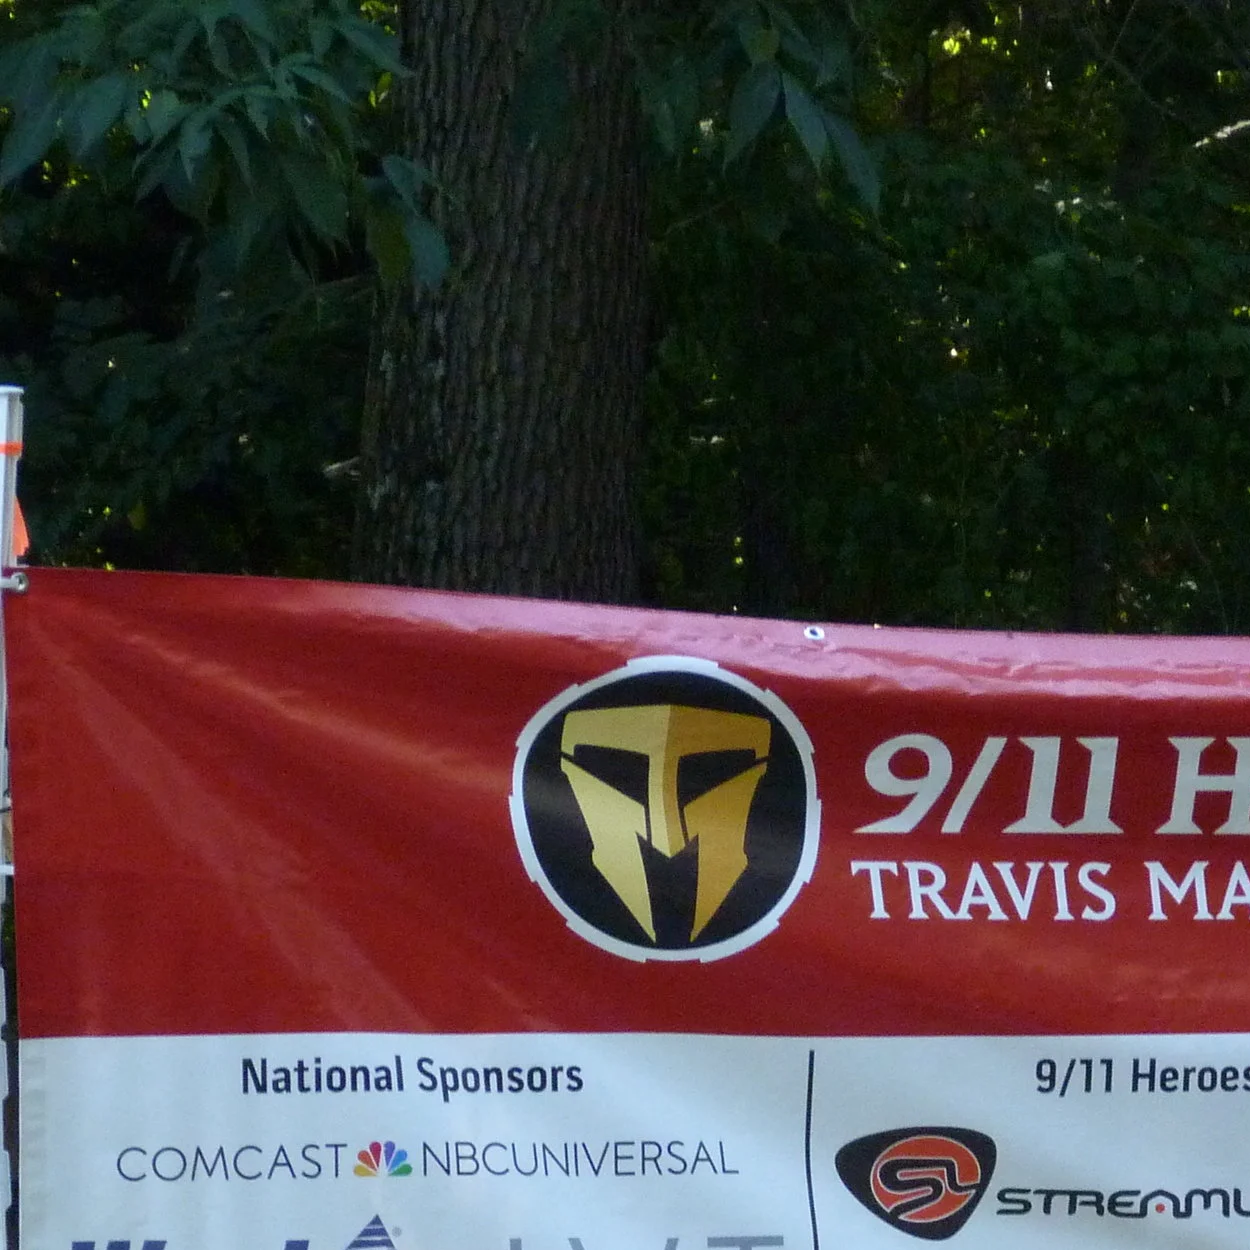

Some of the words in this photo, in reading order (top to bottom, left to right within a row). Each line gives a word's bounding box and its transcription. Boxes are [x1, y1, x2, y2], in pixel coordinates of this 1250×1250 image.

[854, 734, 1127, 835] 9/11
[851, 860, 1118, 923] TRAVIS
[241, 1055, 404, 1094] National
[417, 1056, 584, 1102] Sponsors
[1036, 1059, 1113, 1097] 9/11
[117, 1143, 348, 1182] COMCAST
[422, 1140, 739, 1178] NBCUNIVERSAL
